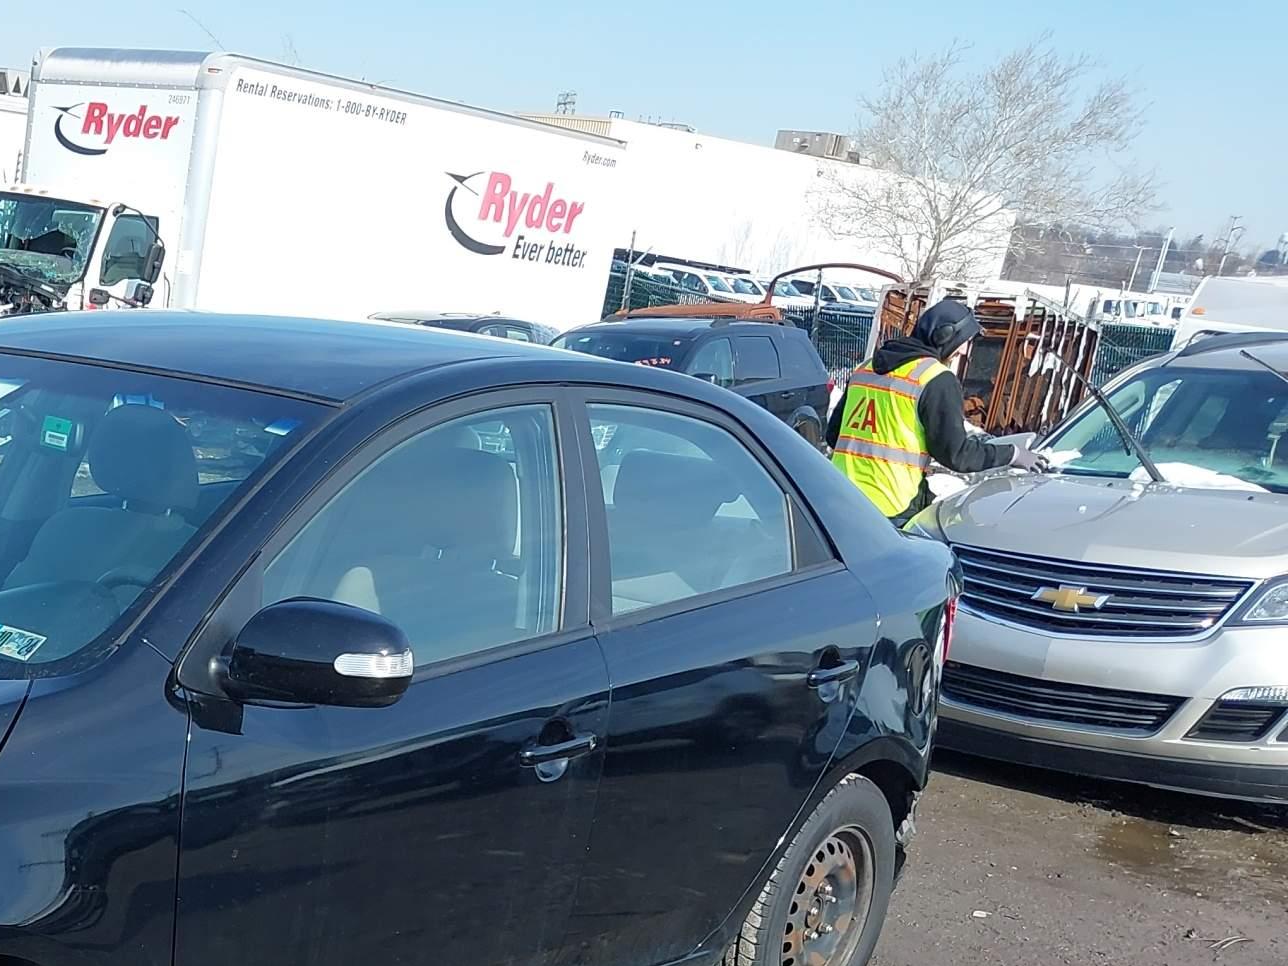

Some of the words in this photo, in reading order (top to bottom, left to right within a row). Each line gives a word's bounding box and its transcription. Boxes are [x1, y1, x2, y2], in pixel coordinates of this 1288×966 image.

[81, 102, 180, 144] Ryder
[236, 78, 268, 97] Rental
[270, 85, 333, 110] Reservations:
[336, 99, 407, 126] 1-800-BY-RYDER
[582, 151, 617, 168] Ryder.com
[478, 171, 585, 238] Ryder
[512, 235, 545, 263] Ever
[545, 240, 587, 268] better.
